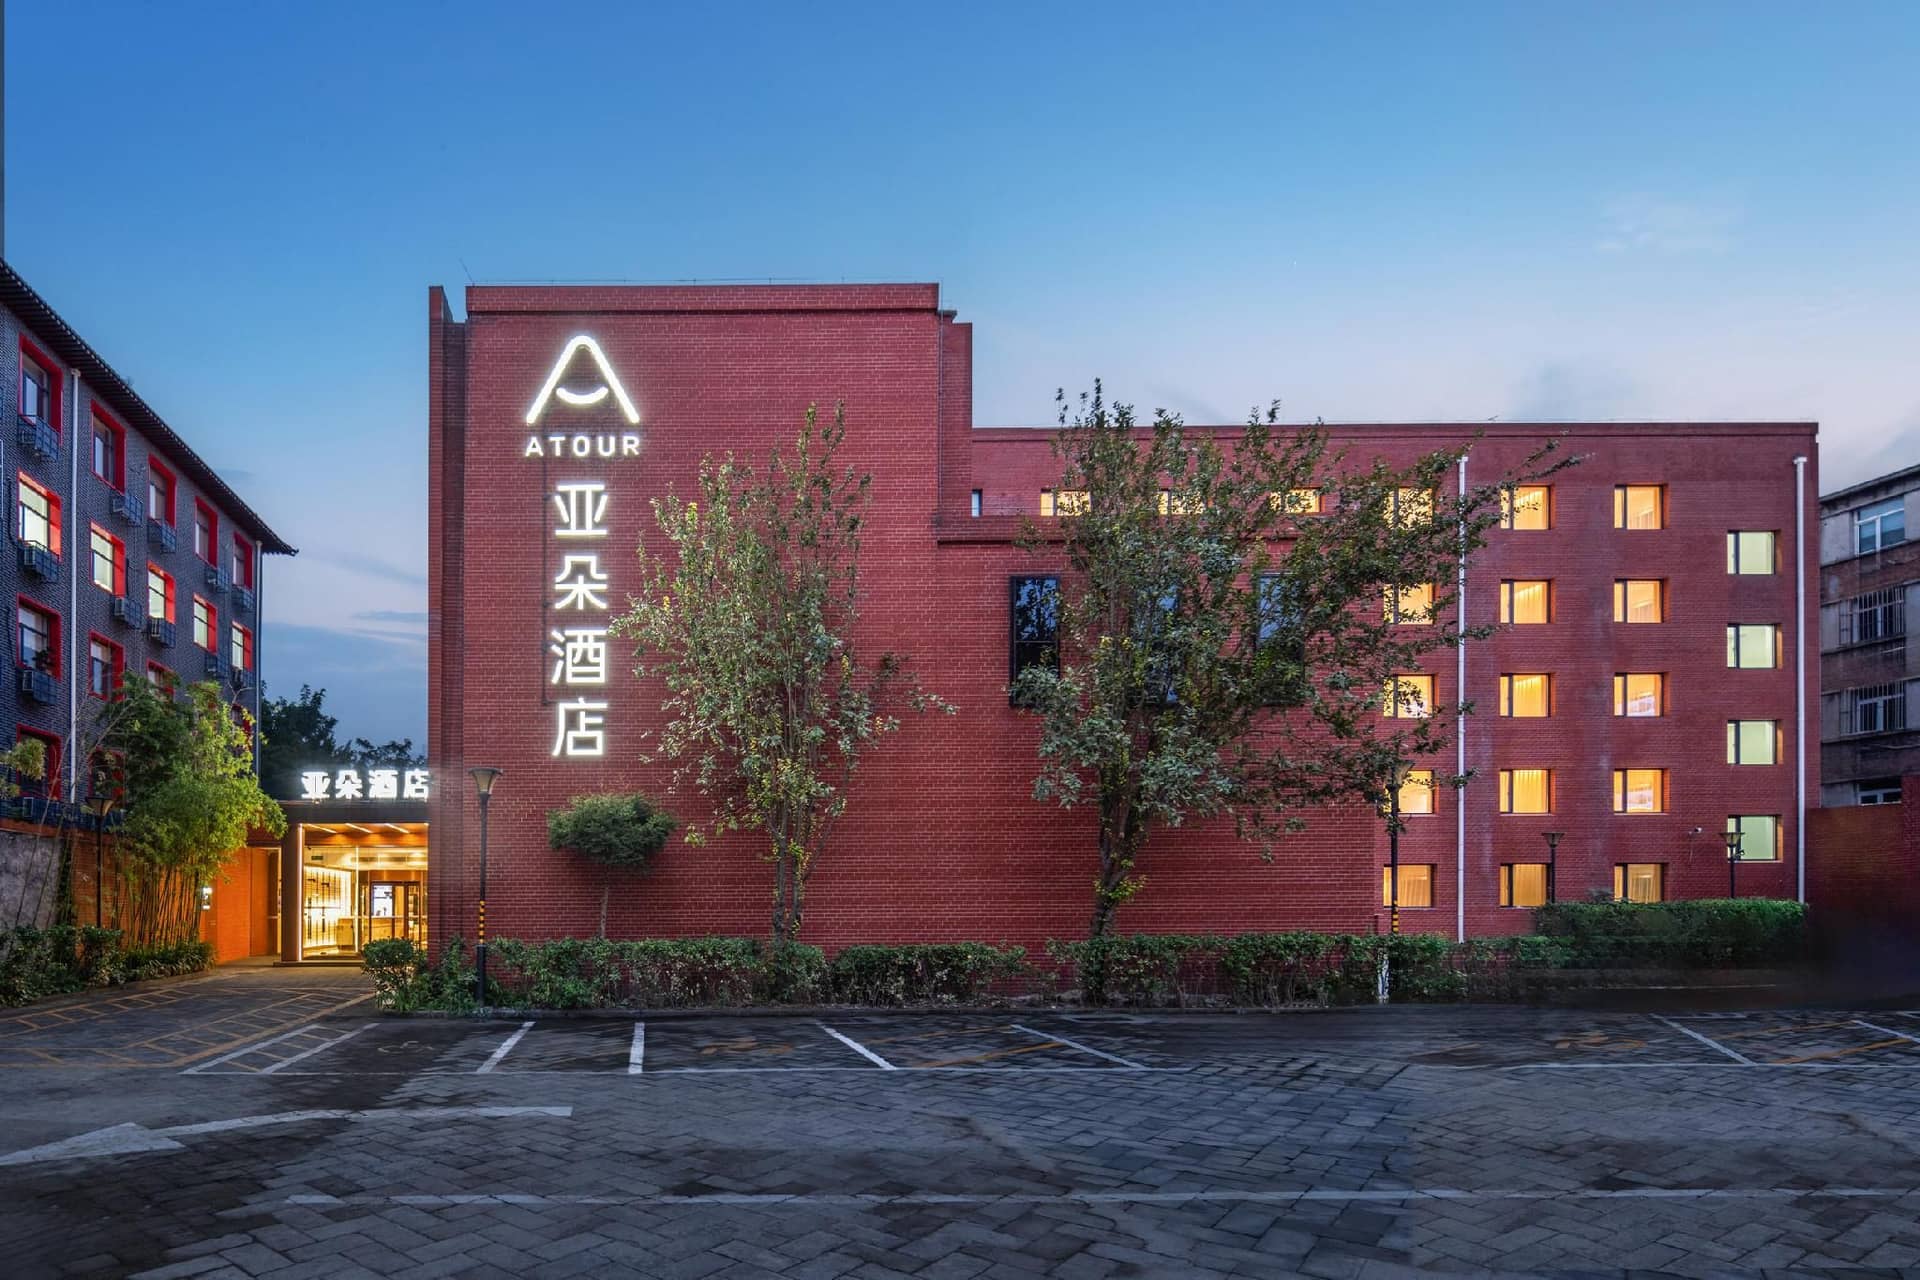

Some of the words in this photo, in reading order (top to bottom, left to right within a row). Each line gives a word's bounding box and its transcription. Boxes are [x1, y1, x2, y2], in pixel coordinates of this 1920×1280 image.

[524, 435, 641, 456] ATOUR
[551, 482, 608, 758] 亚朵酒店
[301, 769, 430, 799] 亚朵酒店
